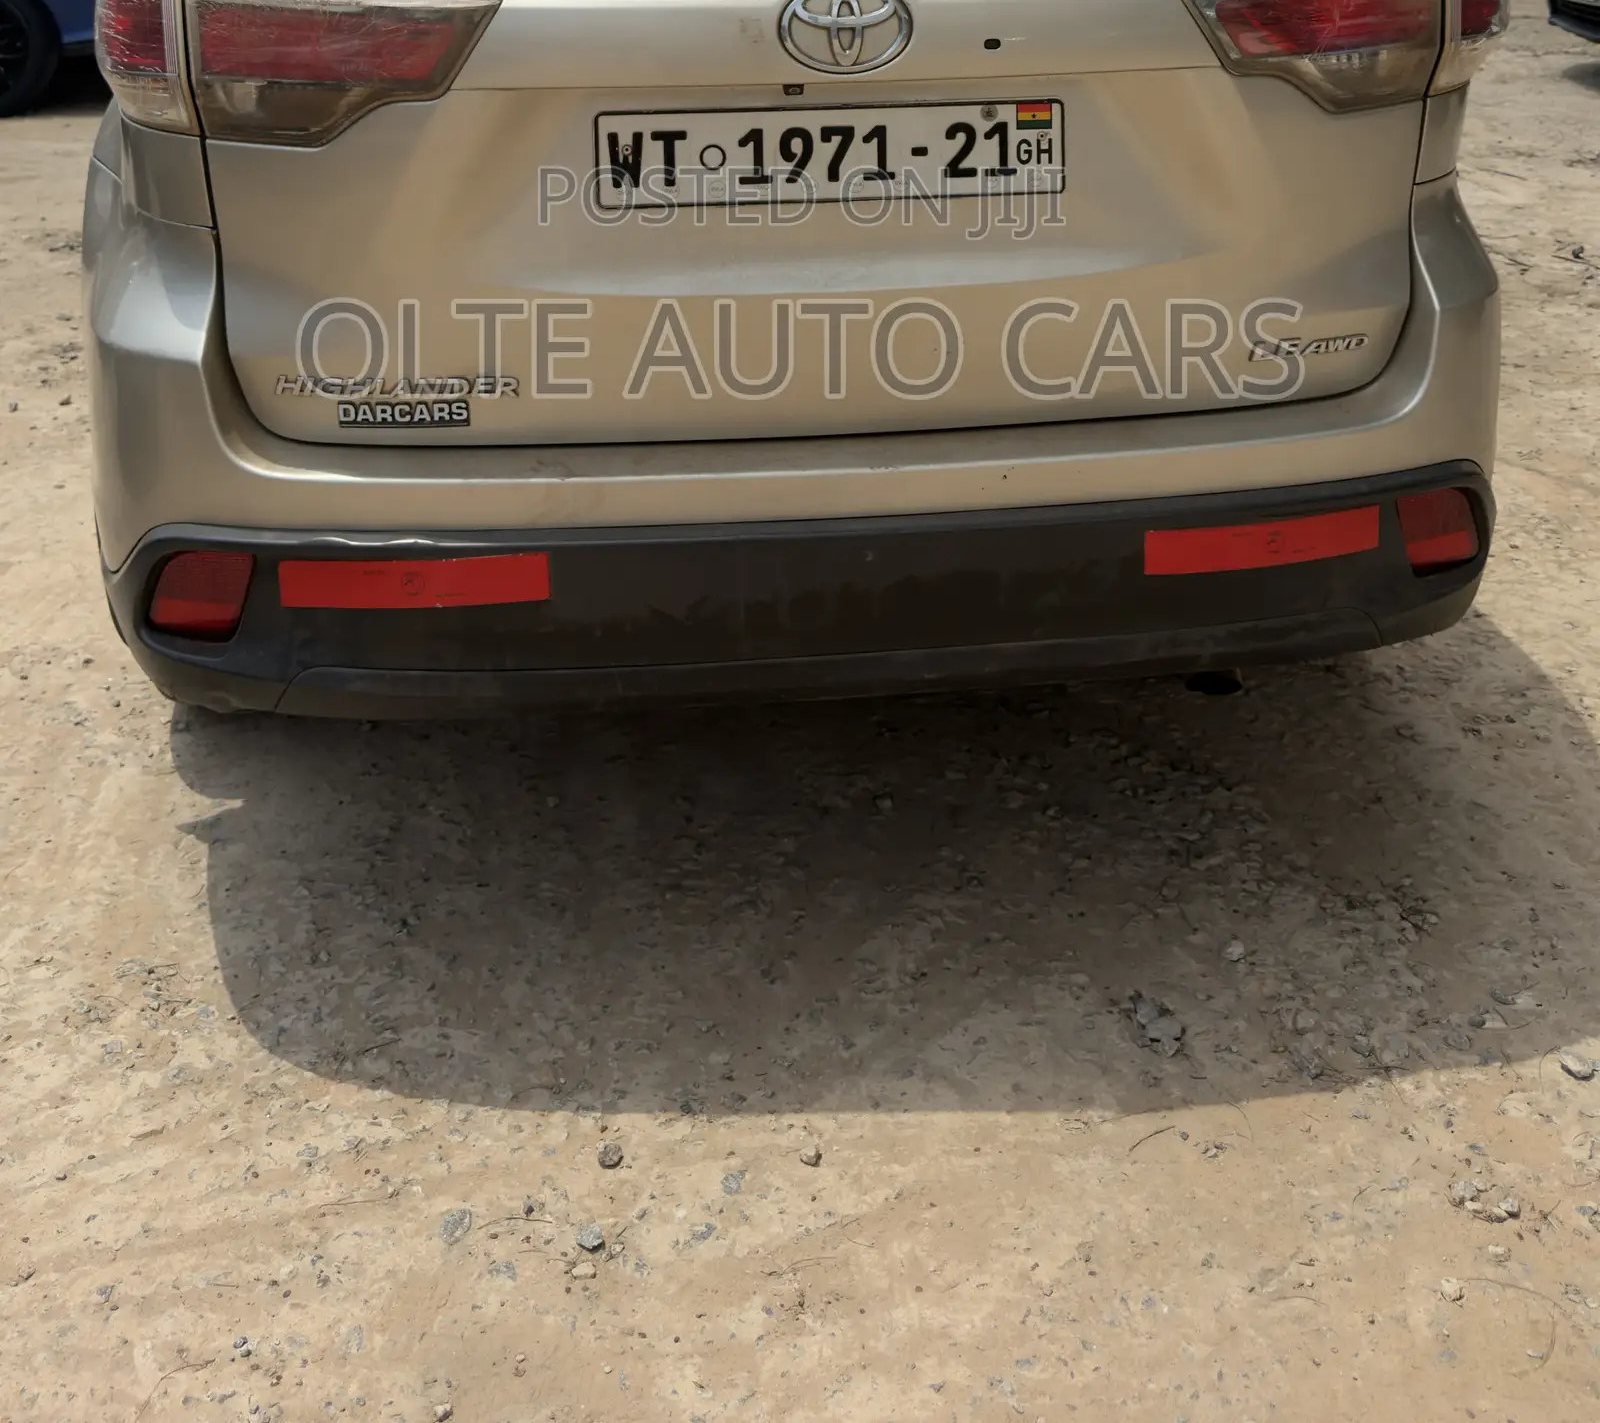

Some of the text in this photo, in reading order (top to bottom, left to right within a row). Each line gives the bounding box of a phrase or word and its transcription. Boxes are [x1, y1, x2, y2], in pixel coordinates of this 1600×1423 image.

[606, 130, 687, 188] WT
[1017, 138, 1053, 165] GH
[1301, 333, 1368, 355] AWD
[275, 375, 519, 398] HIGHLANDER
[339, 402, 468, 421] DARCARS
